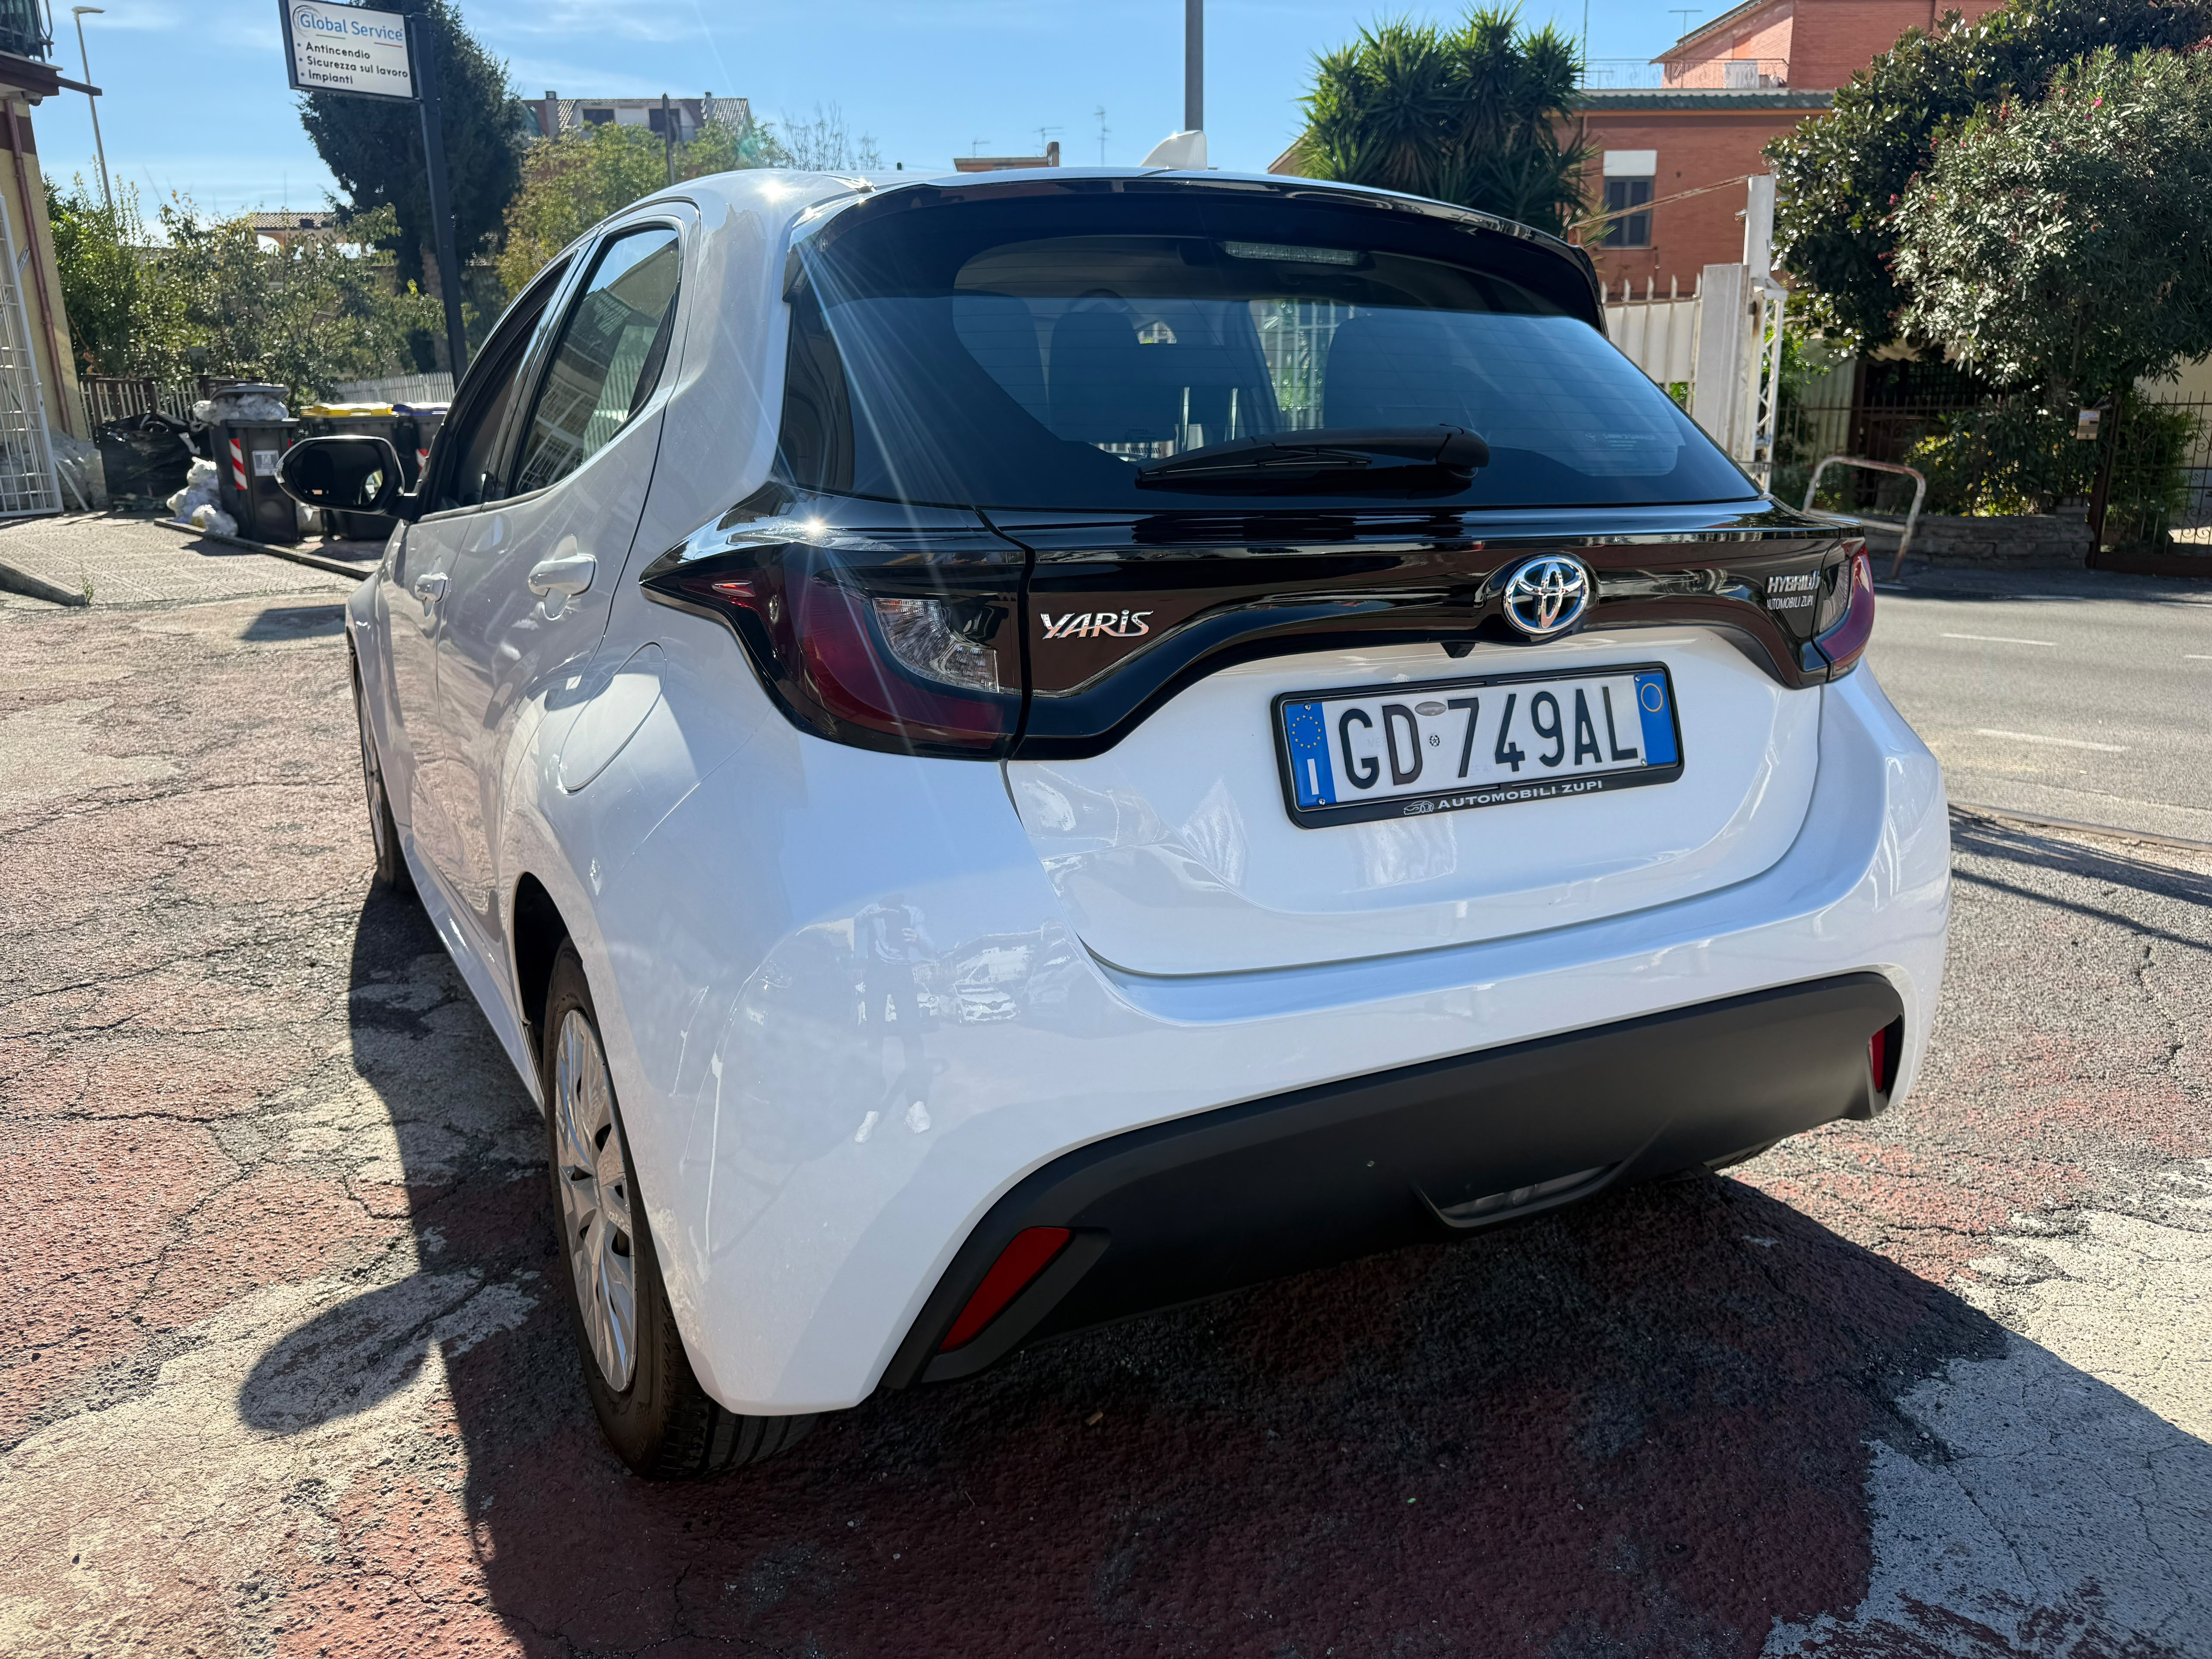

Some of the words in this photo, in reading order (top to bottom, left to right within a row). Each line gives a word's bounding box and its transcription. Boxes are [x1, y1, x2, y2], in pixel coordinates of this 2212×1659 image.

[300, 13, 348, 33] Global
[351, 21, 403, 41] Service
[306, 41, 370, 59] Antincendio
[307, 56, 356, 71] Sicurezza
[360, 65, 373, 73] sul
[377, 65, 408, 78] lavoro
[308, 70, 353, 84] Impianti
[1767, 574, 1813, 594] HYBRID
[1767, 596, 1800, 610] AUTOMOBILI
[1801, 595, 1813, 607] ZUPI
[1437, 786, 1557, 809] AUTOMOBILI
[1561, 780, 1603, 794] ZUPI
